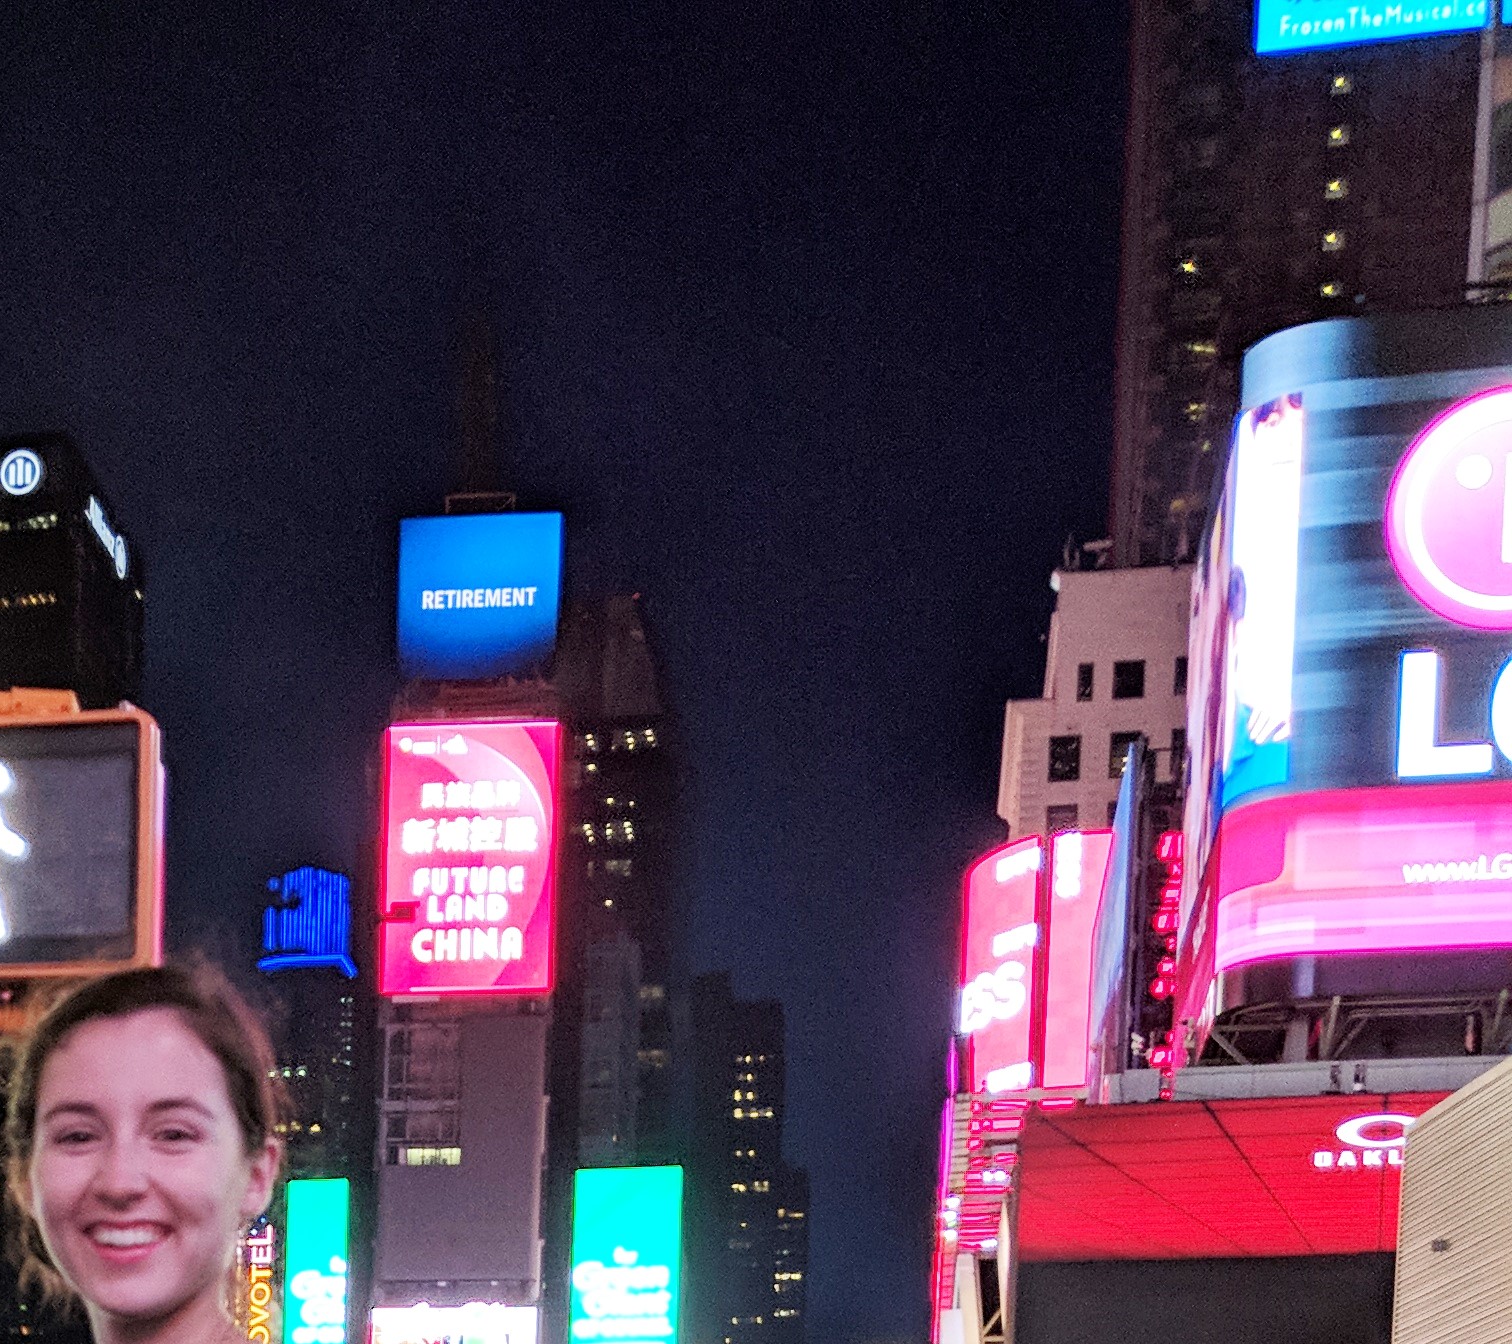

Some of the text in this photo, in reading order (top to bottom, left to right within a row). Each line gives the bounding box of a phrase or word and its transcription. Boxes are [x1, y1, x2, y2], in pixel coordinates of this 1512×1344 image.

[421, 586, 538, 610] RETIREMENT
[412, 866, 525, 897] FUTURE
[427, 895, 509, 923] LAND
[411, 927, 523, 963] CHINA
